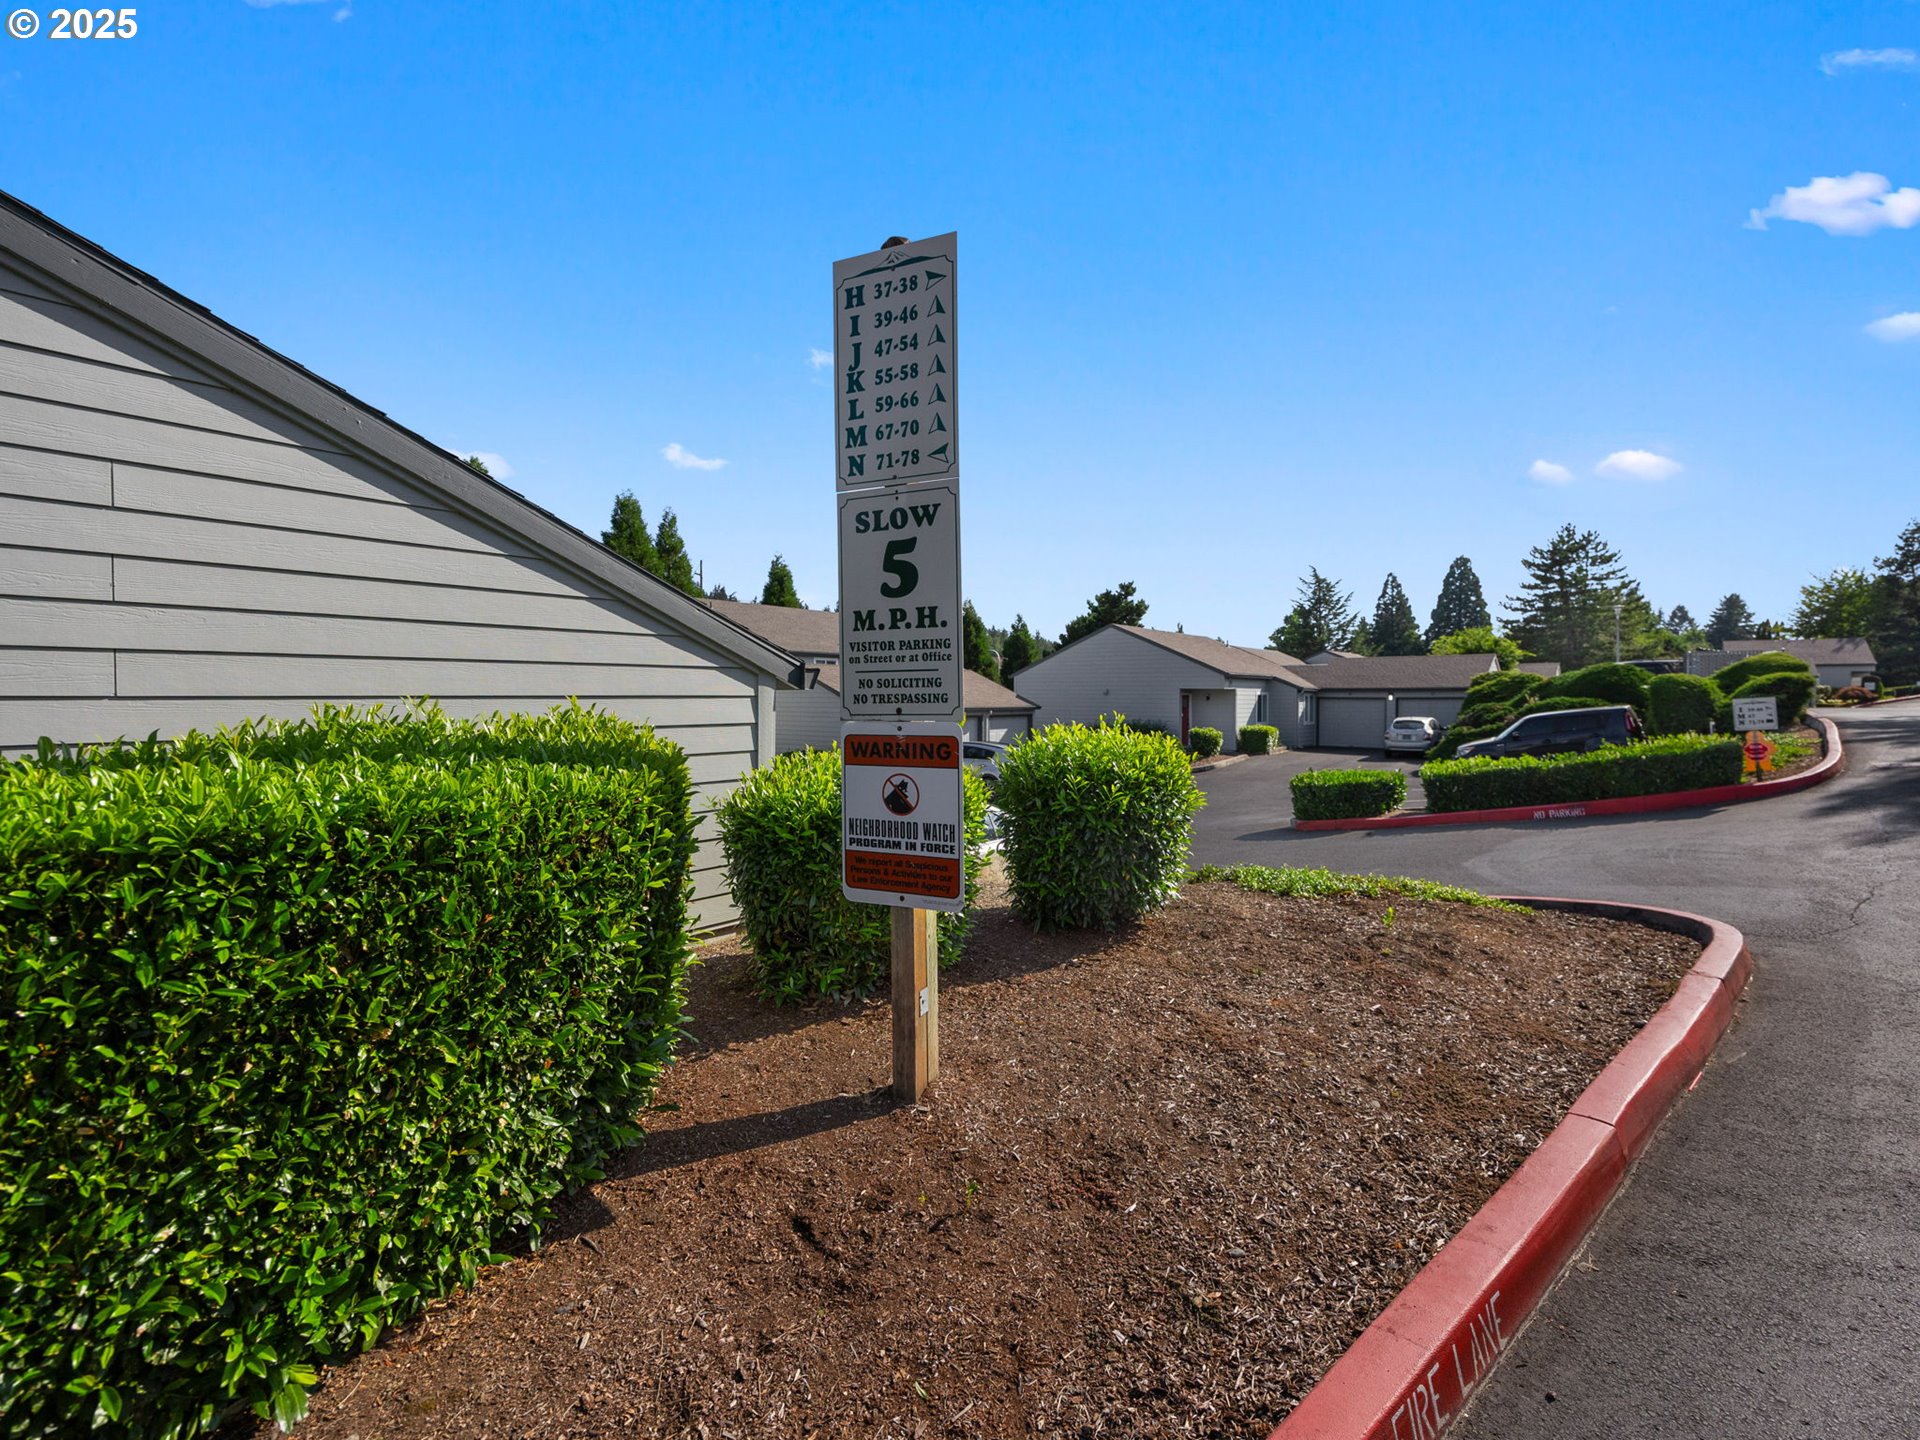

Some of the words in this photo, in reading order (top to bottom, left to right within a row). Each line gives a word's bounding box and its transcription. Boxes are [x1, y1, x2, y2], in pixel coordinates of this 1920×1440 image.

[844, 284, 865, 310] H
[873, 275, 918, 299] 37-38
[850, 315, 860, 337] I
[874, 304, 918, 328] 39-46
[848, 342, 862, 372] J
[874, 333, 919, 357] 47-54
[846, 370, 865, 394] K
[874, 363, 919, 385] 55-58
[848, 399, 864, 421] L
[875, 391, 919, 413] 59-66
[845, 425, 867, 449] M
[875, 419, 919, 441] 67-70
[848, 454, 866, 477] N
[876, 449, 920, 471] 71-78
[855, 503, 941, 533] SLOW
[880, 536, 919, 598] 5
[853, 606, 948, 632] M.P.H.
[848, 656, 860, 664] on
[863, 654, 893, 663] Street
[909, 654, 919, 662] at
[922, 652, 952, 661] Office
[849, 641, 895, 652] VISITOR
[899, 638, 951, 650] PARKING
[858, 679, 873, 689] NO
[876, 677, 942, 688] SOLICITING
[853, 694, 868, 704] NO
[871, 693, 949, 704] TRESPASSING
[850, 741, 952, 760] WARNING
[1533, 810, 1545, 819] NO
[1549, 807, 1586, 819] PARKING
[848, 817, 918, 840] NEIGHBORHOOD
[923, 822, 955, 843] WATCH
[849, 837, 901, 850] PROGRAM
[905, 842, 916, 851] IN
[920, 843, 955, 854] FORCE
[868, 858, 892, 867] report
[1453, 1290, 1510, 1398] LANE
